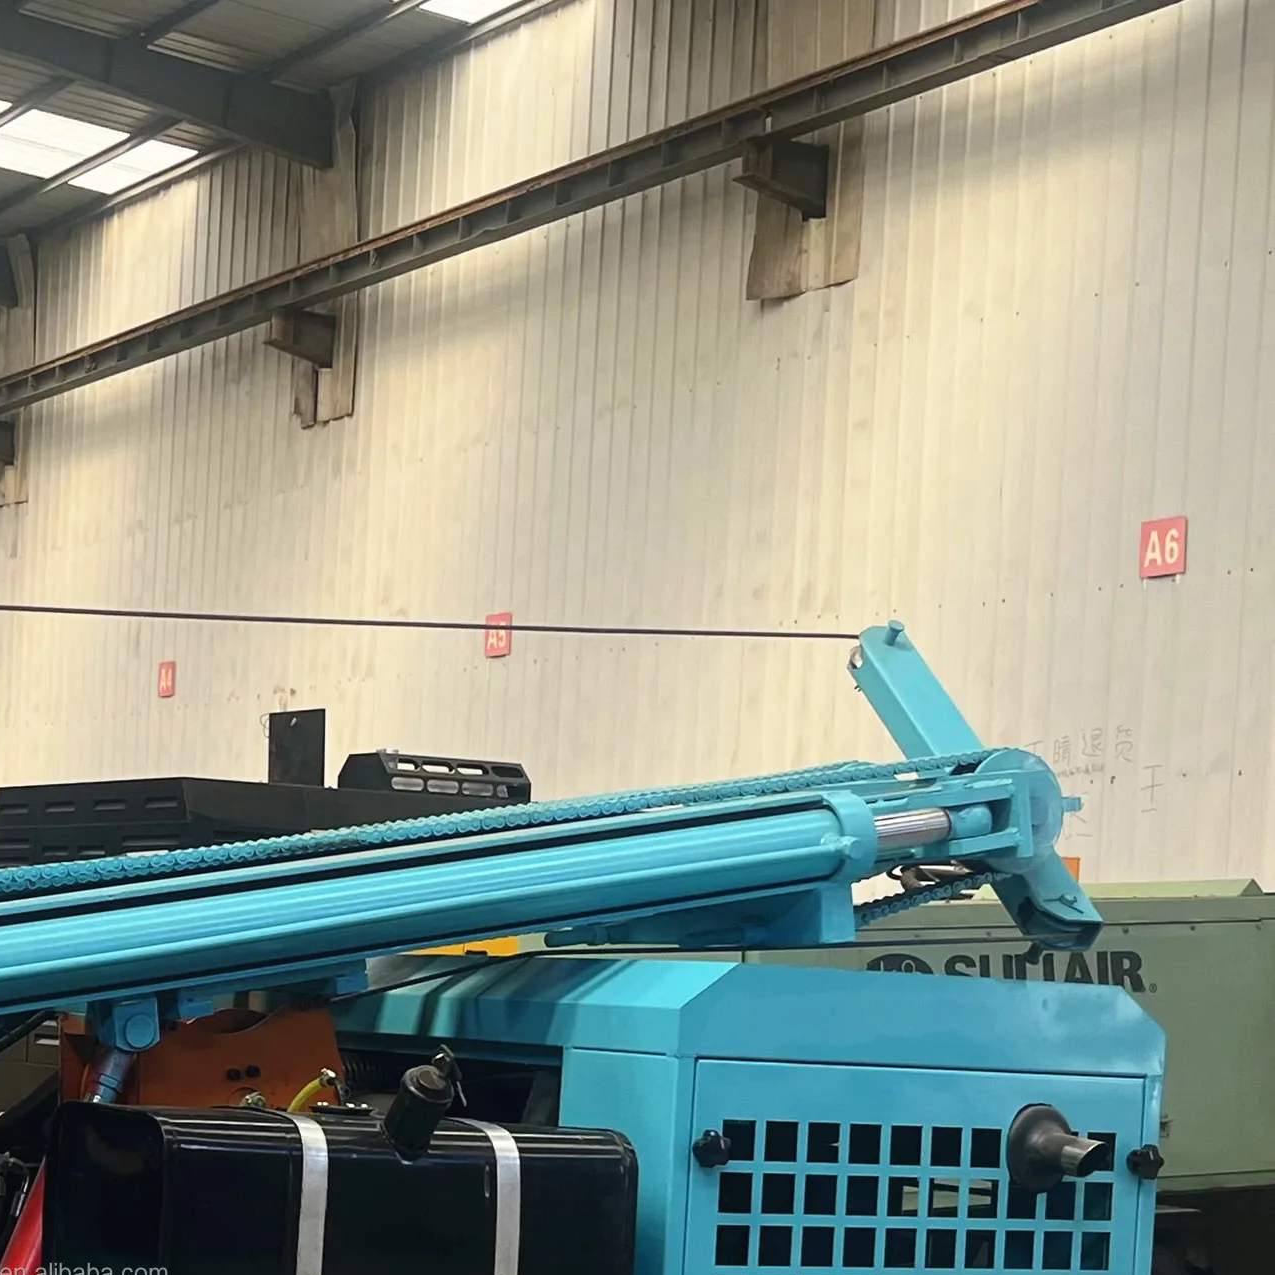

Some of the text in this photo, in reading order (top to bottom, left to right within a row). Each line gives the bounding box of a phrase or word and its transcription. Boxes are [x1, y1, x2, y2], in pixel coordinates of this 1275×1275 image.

[1143, 528, 1180, 568] A6
[486, 621, 507, 650] A5
[159, 668, 173, 692] A4
